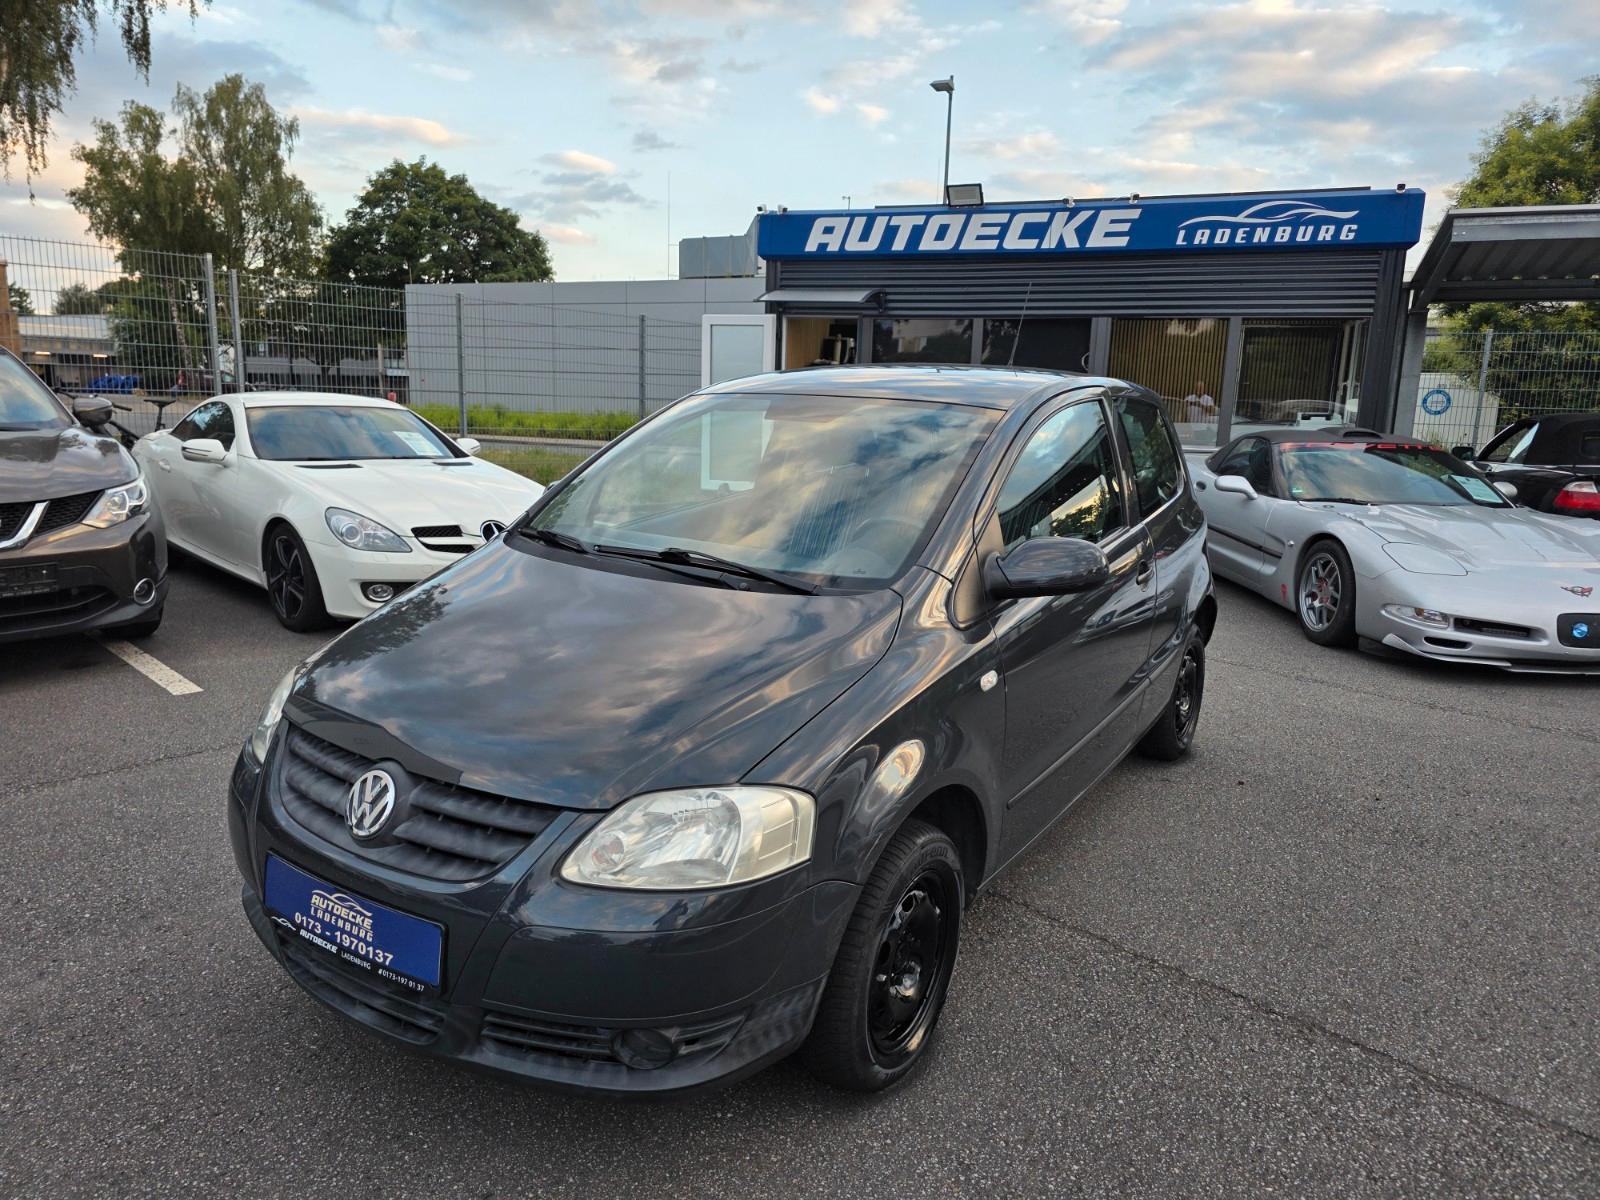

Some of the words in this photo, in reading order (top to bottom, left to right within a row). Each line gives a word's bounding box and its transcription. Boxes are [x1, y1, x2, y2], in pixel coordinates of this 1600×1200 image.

[804, 208, 1142, 252] AUTOECKE
[1176, 224, 1358, 246] LADENBURG
[311, 894, 373, 929] AUTOECKE
[311, 906, 373, 942] LADENBURG
[295, 912, 321, 934] 0173
[335, 931, 393, 965] 1970137
[300, 929, 338, 953] AUTOECKE
[341, 951, 371, 970] LADENBURG
